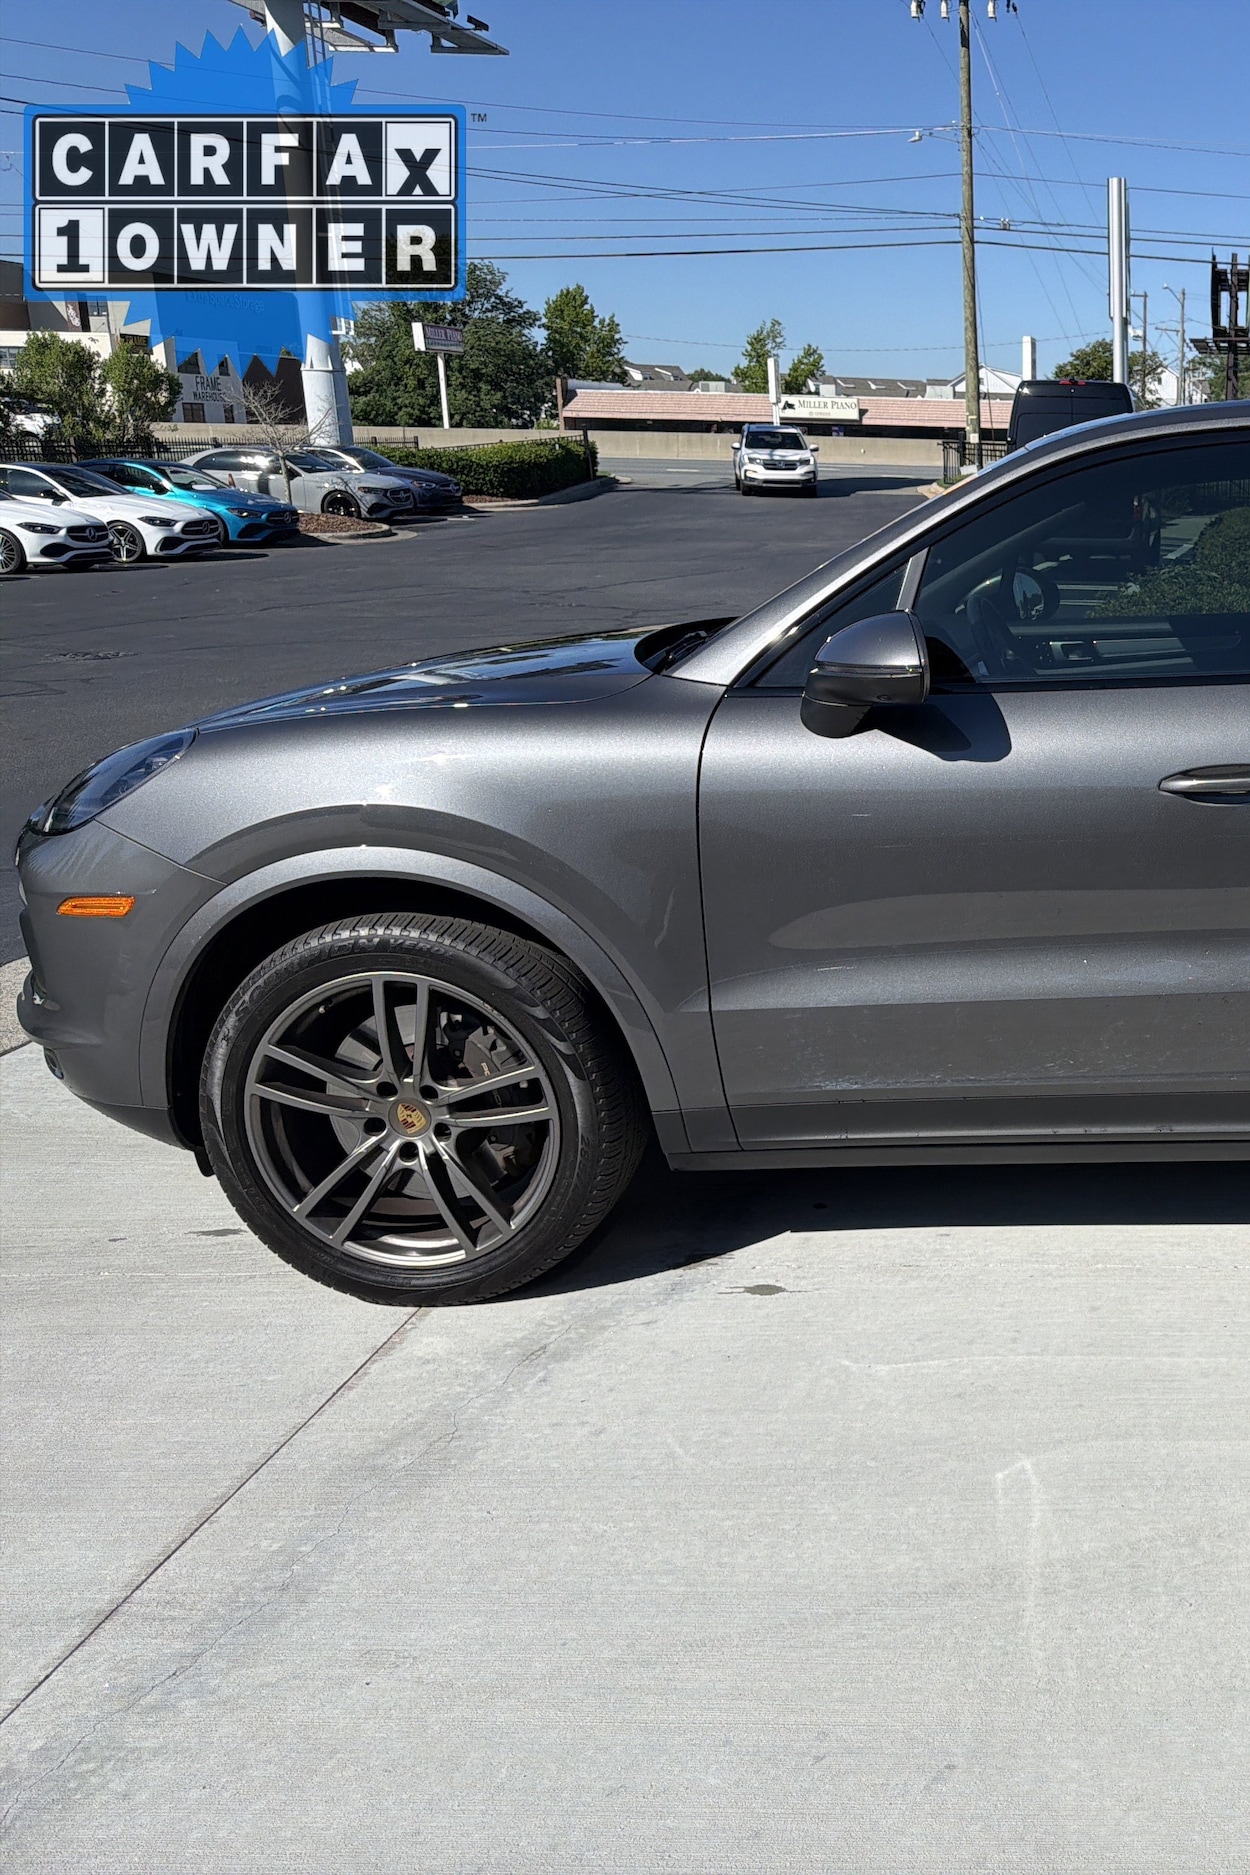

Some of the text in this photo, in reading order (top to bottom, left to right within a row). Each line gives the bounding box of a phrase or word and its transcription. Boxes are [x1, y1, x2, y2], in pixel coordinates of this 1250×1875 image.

[195, 375, 222, 391] FRAME
[798, 400, 857, 410] MILLER PIANO
